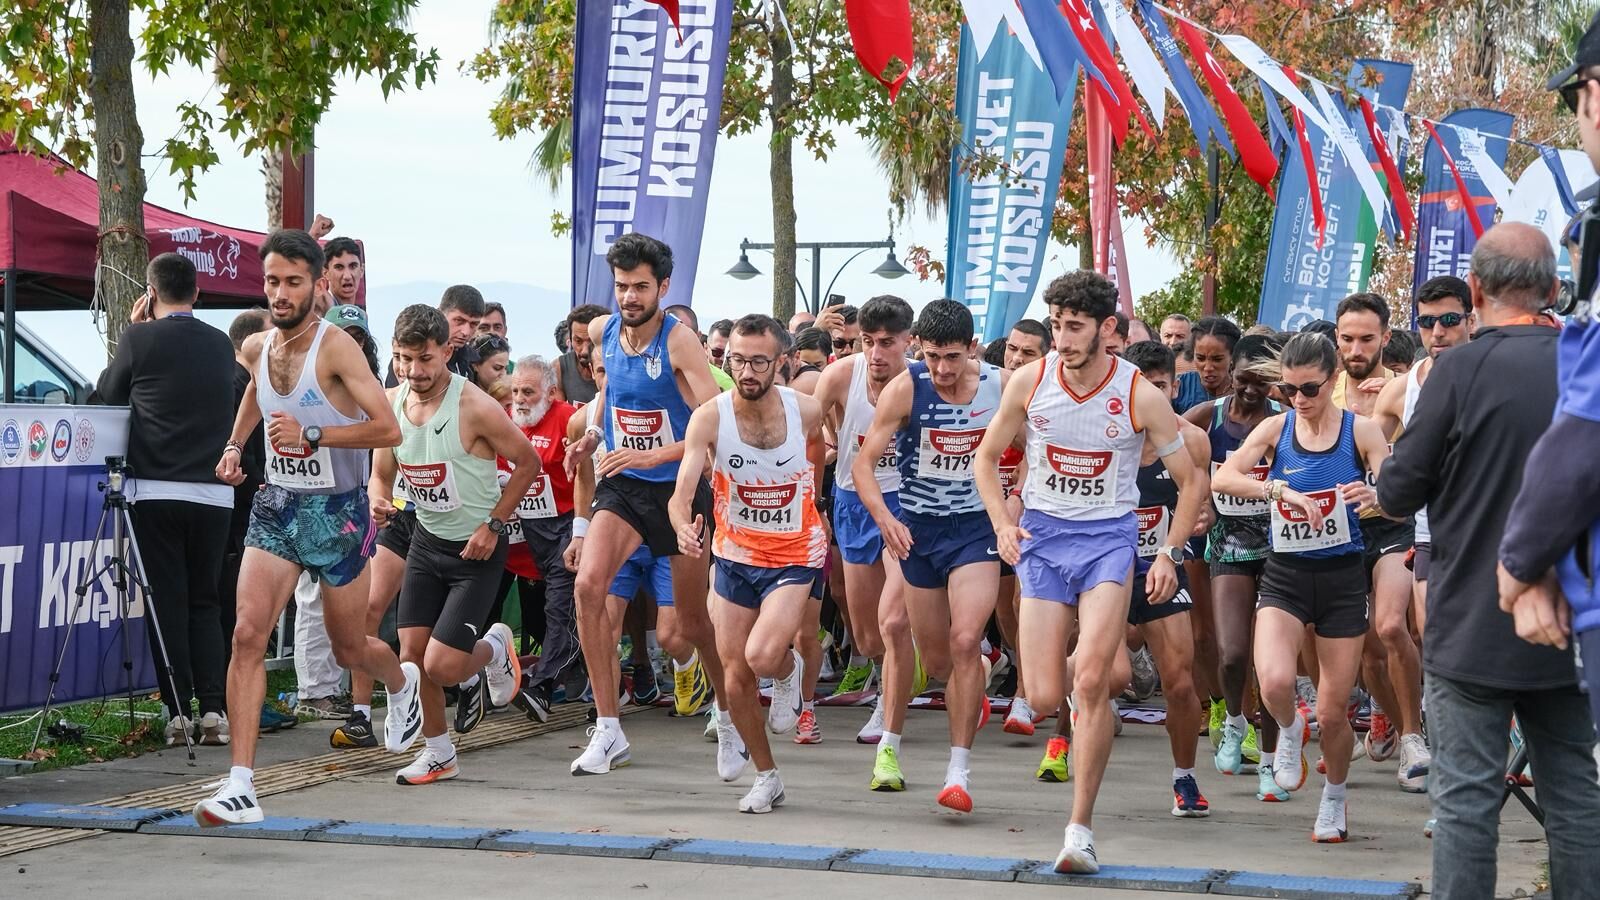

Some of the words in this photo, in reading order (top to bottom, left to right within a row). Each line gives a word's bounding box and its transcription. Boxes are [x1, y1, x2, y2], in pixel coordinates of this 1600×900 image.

[594, 0, 659, 255] CUMHURİY
[299, 400, 323, 408] adidas
[621, 435, 663, 451] 41871
[935, 434, 980, 445] CUMHURİYET
[943, 443, 971, 453] KOŞUSU
[271, 456, 321, 477] 41540
[930, 453, 977, 471] 4179
[1052, 453, 1105, 467] CUMHURİYET
[1060, 463, 1094, 475] KOŞUSU
[1045, 474, 1105, 496] 41955
[743, 489, 791, 499] CUMHURİYET
[751, 498, 782, 507] KOŞUSU
[738, 507, 791, 524] 41041
